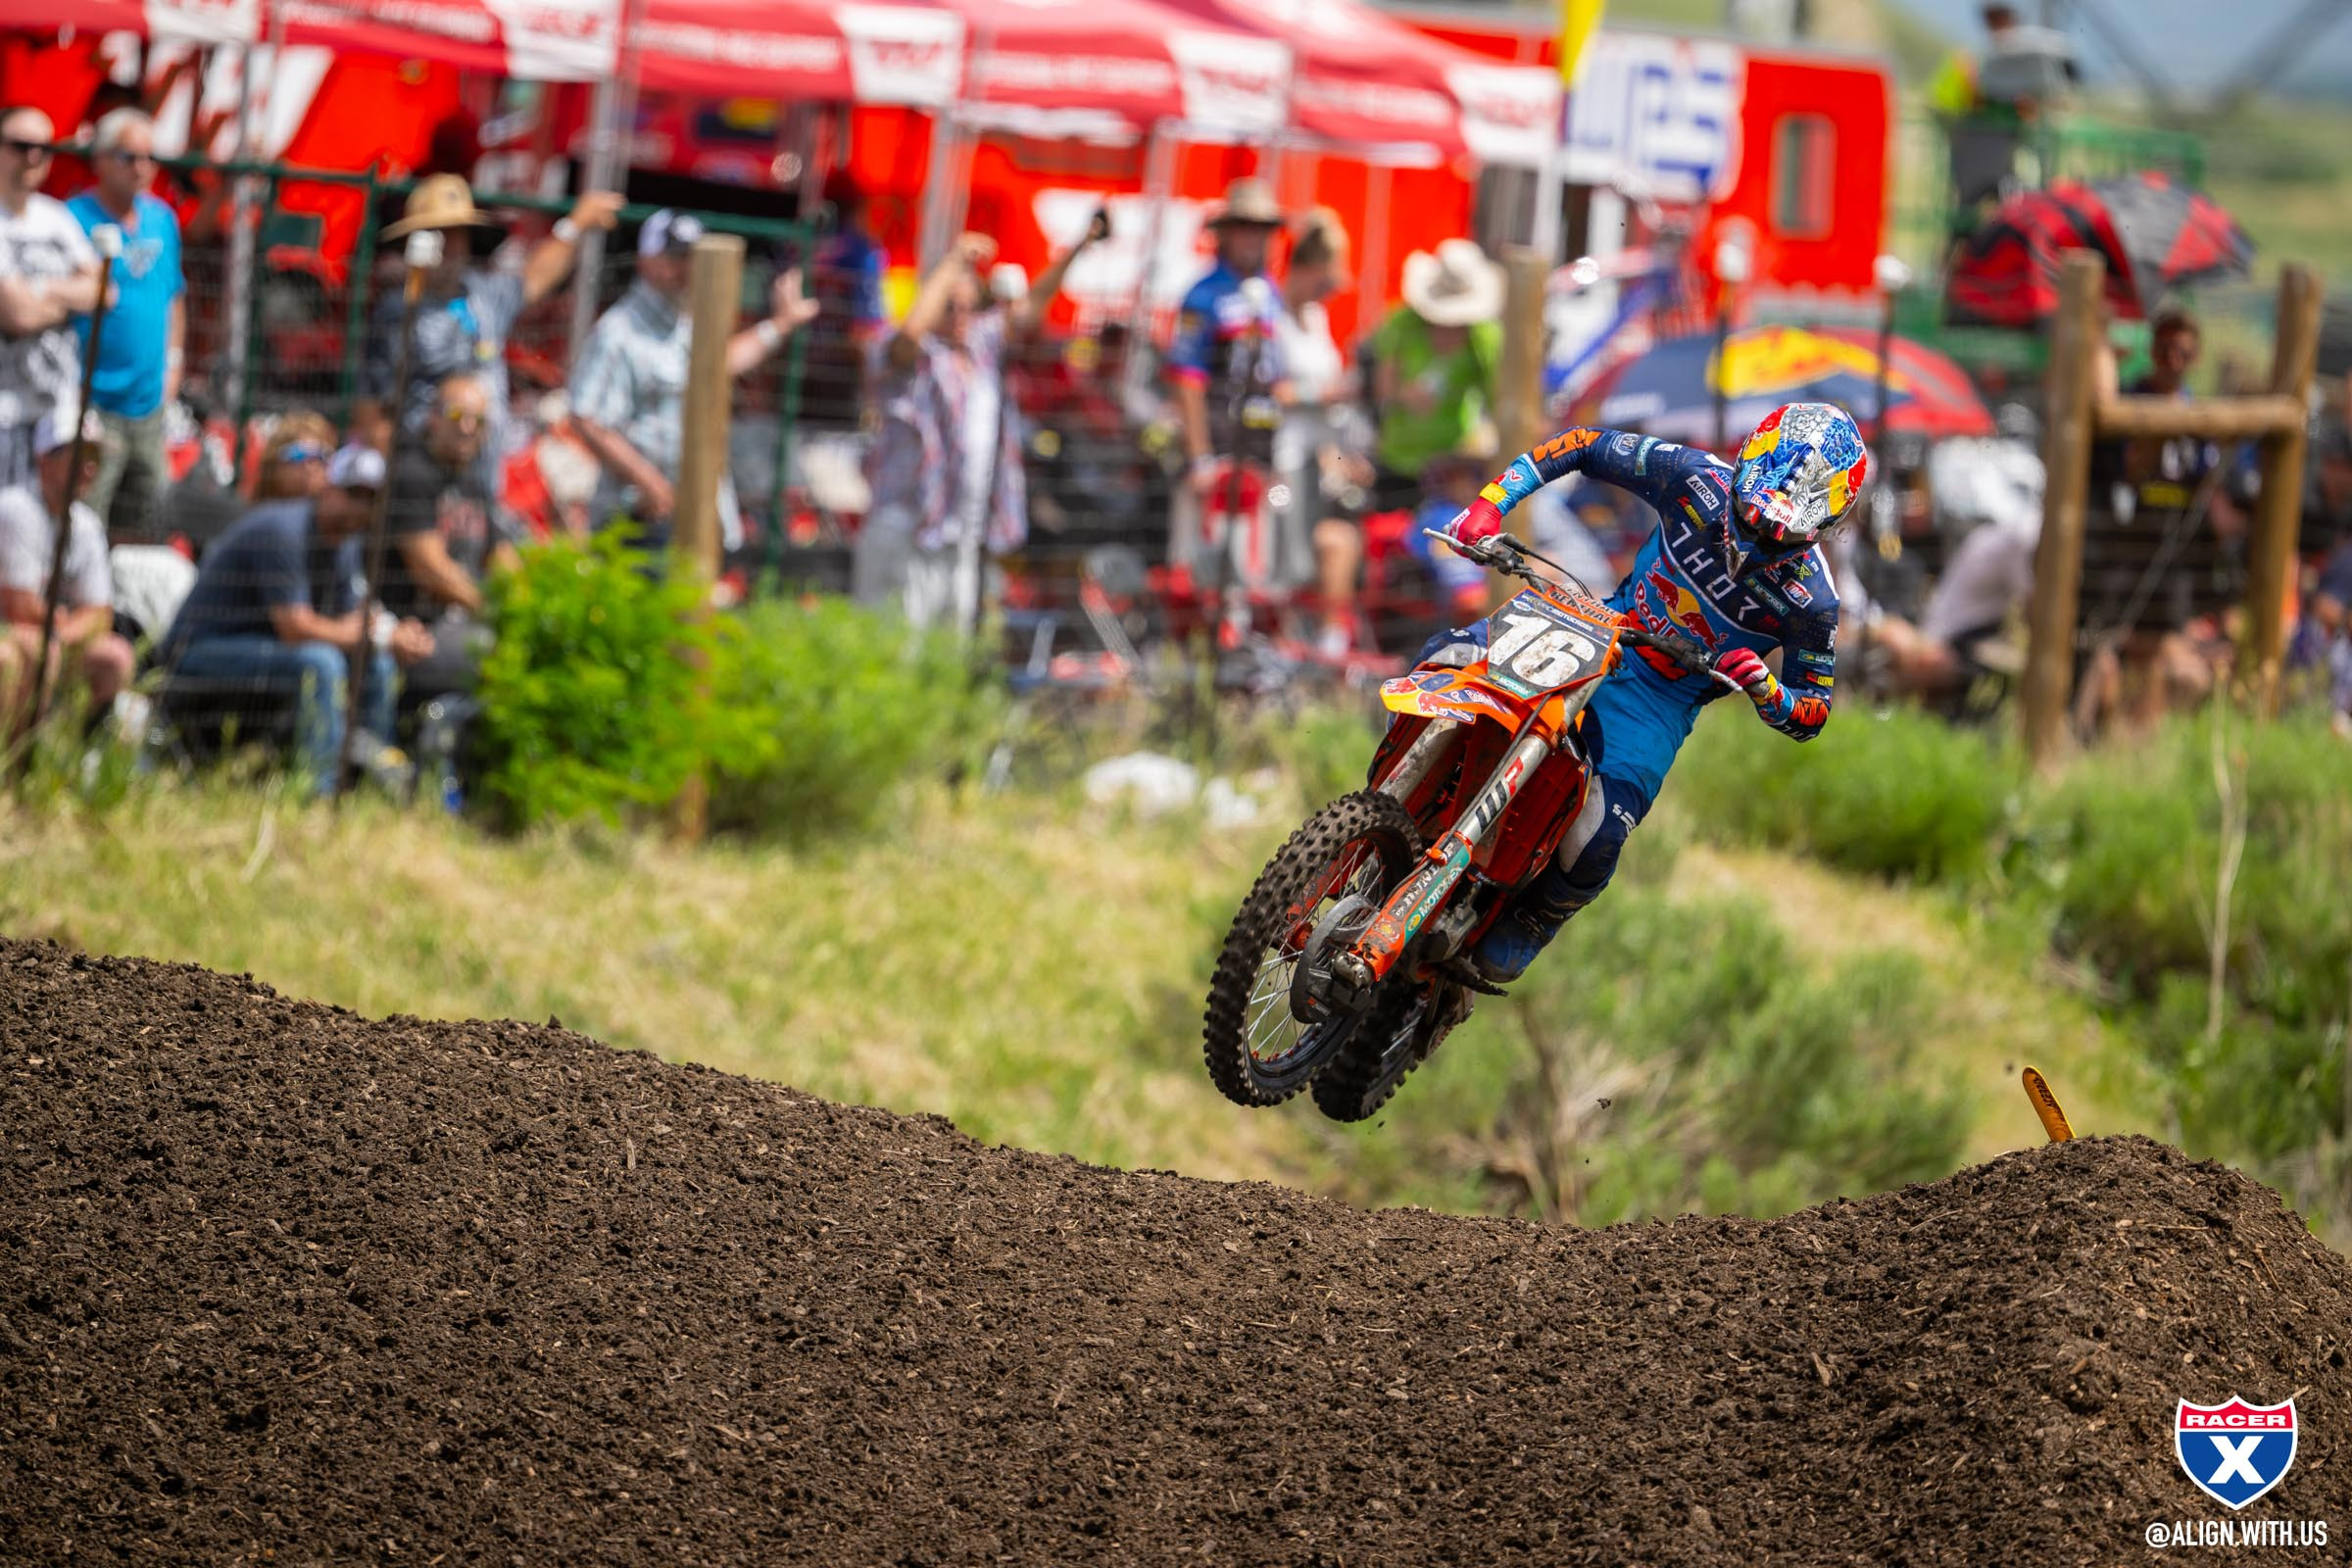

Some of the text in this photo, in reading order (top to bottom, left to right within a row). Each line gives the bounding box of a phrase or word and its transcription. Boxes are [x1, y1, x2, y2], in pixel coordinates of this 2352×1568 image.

[1741, 464, 1762, 493] AIROH
[1689, 479, 1717, 508] AIROH
[1799, 501, 1824, 527] AIROH
[1787, 584, 1808, 605] 100%
[1488, 613, 1595, 687] 16
[1403, 842, 1455, 909] DUNLP
[1418, 864, 1464, 918] MOTOREX
